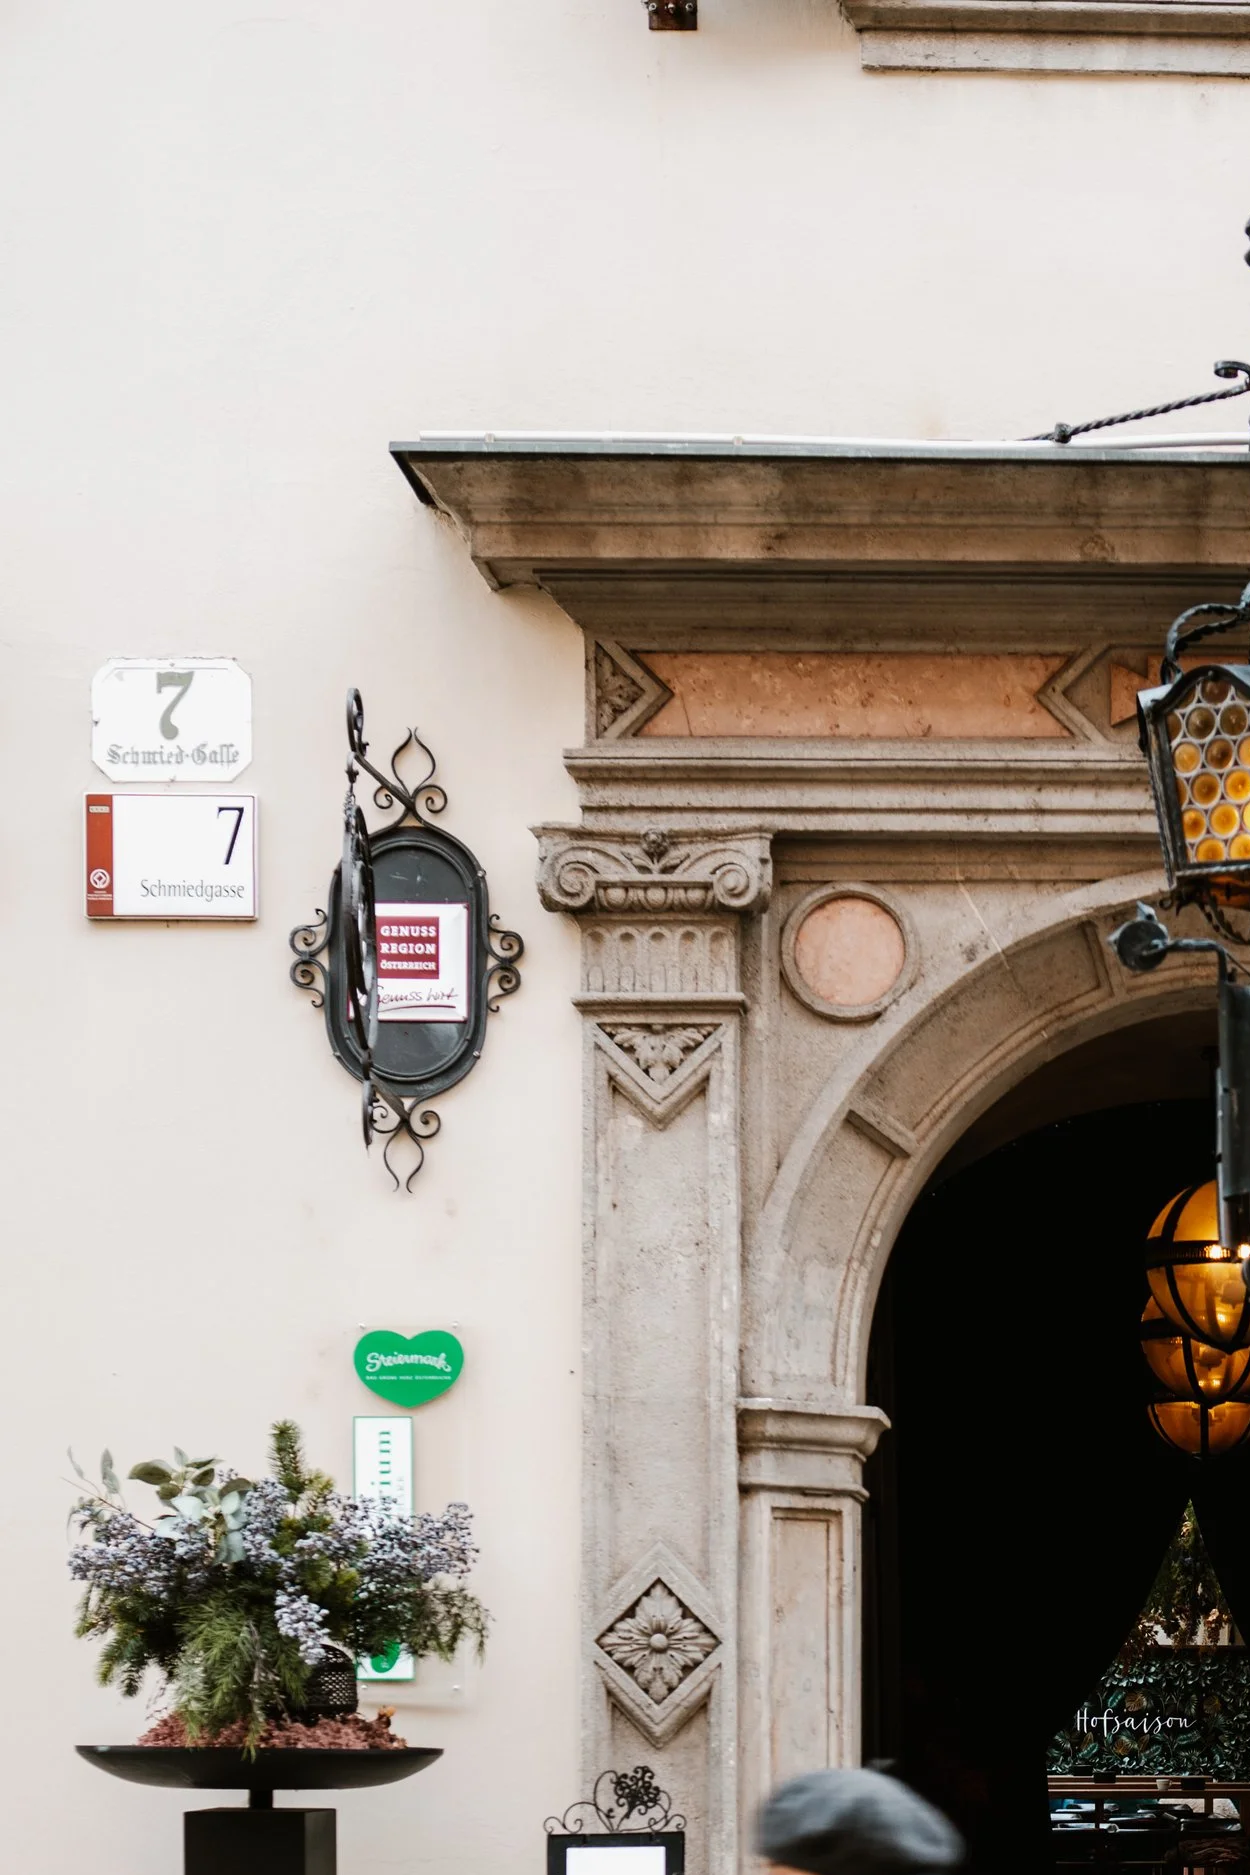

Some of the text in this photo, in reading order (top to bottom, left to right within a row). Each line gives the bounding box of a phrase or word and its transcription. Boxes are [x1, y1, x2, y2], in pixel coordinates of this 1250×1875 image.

[156, 670, 195, 740] 7
[216, 806, 245, 865] 7
[140, 879, 245, 902] Schmiedgasse
[380, 925, 437, 938] GENUSS
[380, 942, 437, 955] REGION
[380, 959, 437, 971] ÖSTERREICH
[365, 1351, 453, 1373] Steiermark
[1076, 1707, 1197, 1738] Hofsaison
